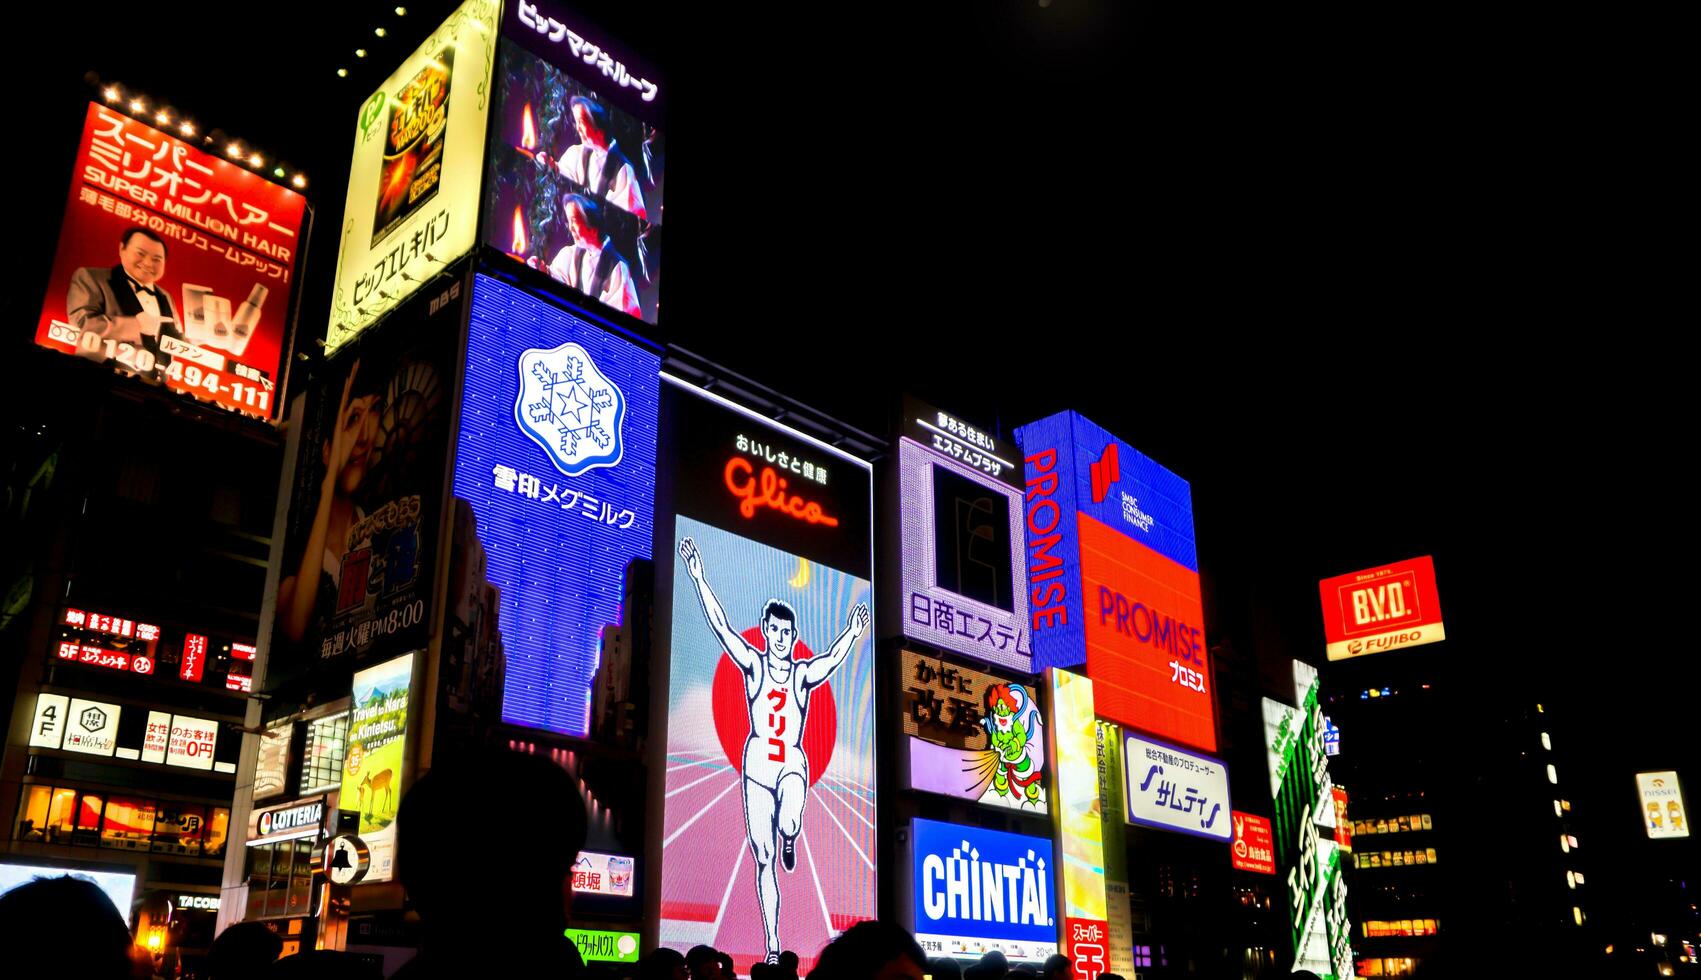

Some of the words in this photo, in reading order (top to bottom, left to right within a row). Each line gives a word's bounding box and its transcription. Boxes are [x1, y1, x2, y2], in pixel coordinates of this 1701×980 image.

[518, 0, 659, 102] ピップマグネループ
[94, 112, 213, 177] スーパー
[88, 137, 295, 237] ミリオンヘアー
[84, 165, 158, 206] SUPER
[163, 201, 239, 241] MILLION
[243, 230, 291, 262] HAIR
[353, 210, 449, 305] ピップエレキバン
[163, 339, 205, 361] ルアン
[80, 331, 270, 411] 0120-494-111
[937, 411, 995, 452] 夢ある住まい
[735, 433, 828, 485] おいしさと健康
[933, 435, 1002, 477] エステムプラザ
[492, 463, 635, 530] 雪印メグミルク
[1121, 490, 1138, 508] SMBC
[1122, 501, 1155, 528] CONSUMER
[1024, 447, 1069, 631] PROMISE
[1123, 510, 1149, 533] FINANCE
[1352, 581, 1412, 625] B.V.D.
[911, 592, 1034, 658] 日商エステム
[1098, 584, 1203, 666] PROMISE
[1366, 631, 1421, 650] FUJIBO
[59, 643, 79, 659] 5F
[1169, 660, 1206, 694] プロミス
[353, 703, 378, 723] Travel
[385, 697, 407, 713] Nara
[766, 688, 789, 764] グリコ
[148, 722, 215, 742] 女性のお客様
[1145, 747, 1216, 776] 総合不動産のプロデューサー
[1155, 779, 1208, 816] サムティ
[272, 803, 322, 830] LOTTERIA
[572, 871, 601, 891] 頓堀
[576, 933, 614, 957] ピタットハウス
[921, 939, 943, 952] 天気予報
[1073, 923, 1103, 942] スーパー
